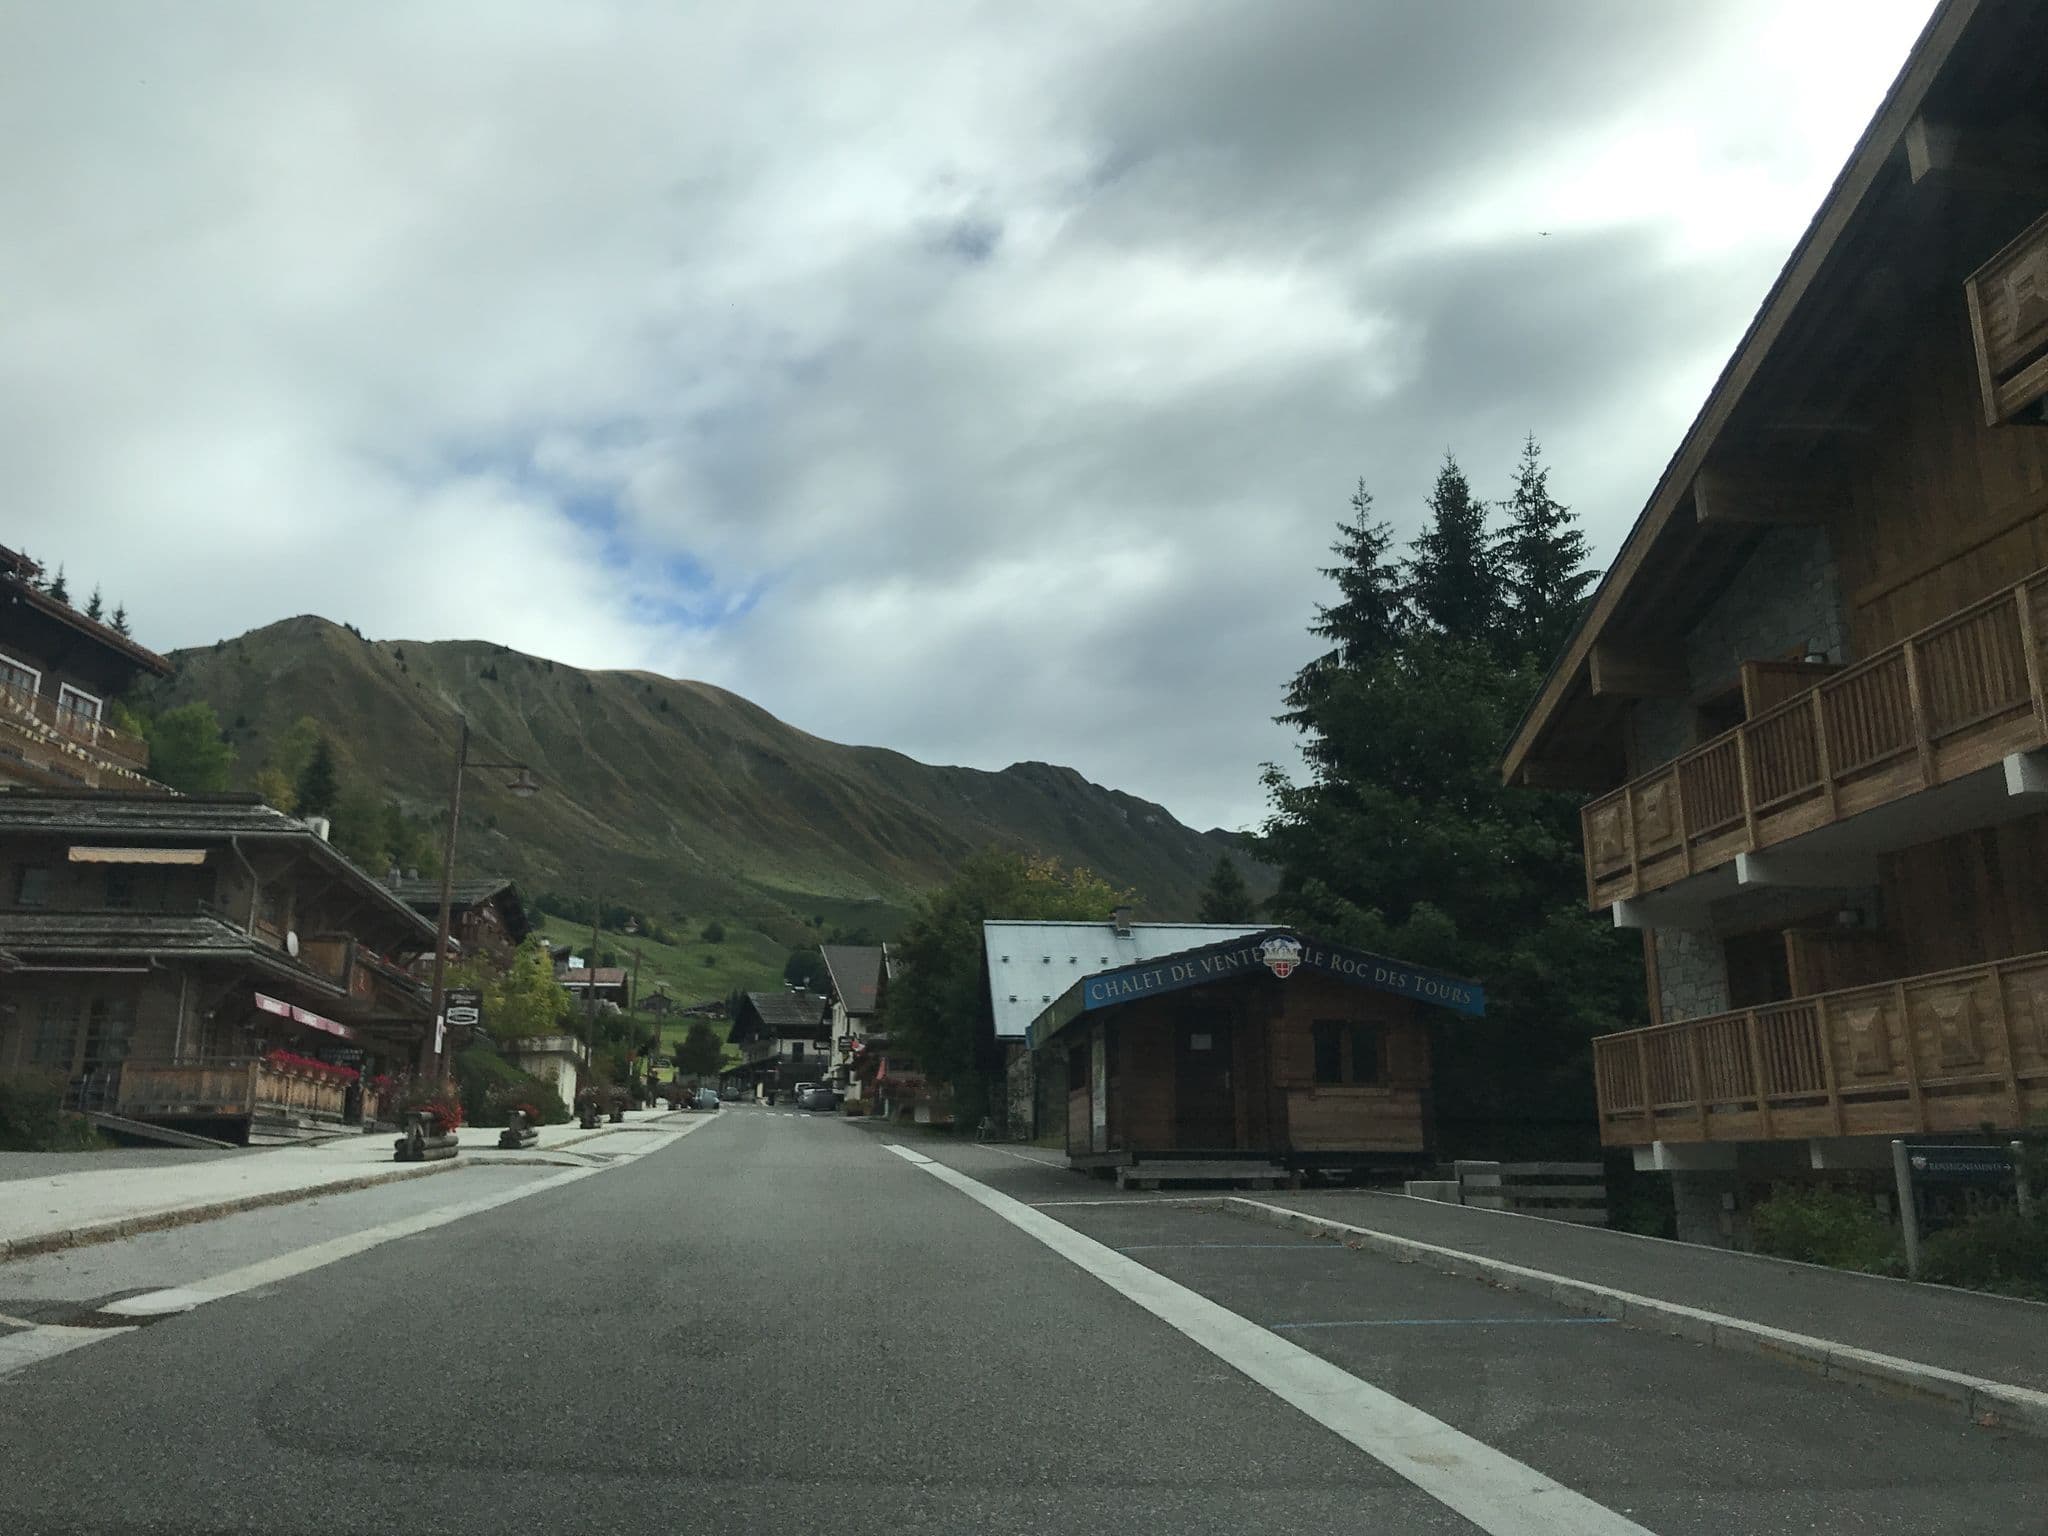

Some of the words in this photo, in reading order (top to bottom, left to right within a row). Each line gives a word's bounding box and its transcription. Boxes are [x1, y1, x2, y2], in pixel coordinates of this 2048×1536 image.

[1091, 970, 1163, 1000] CHALET
[1173, 963, 1196, 983] DE
[1202, 947, 1263, 973] VENTE
[1304, 947, 1323, 966] LE
[1331, 951, 1367, 977] ROC
[1374, 967, 1406, 987] DES
[1415, 977, 1472, 1005] TOURS
